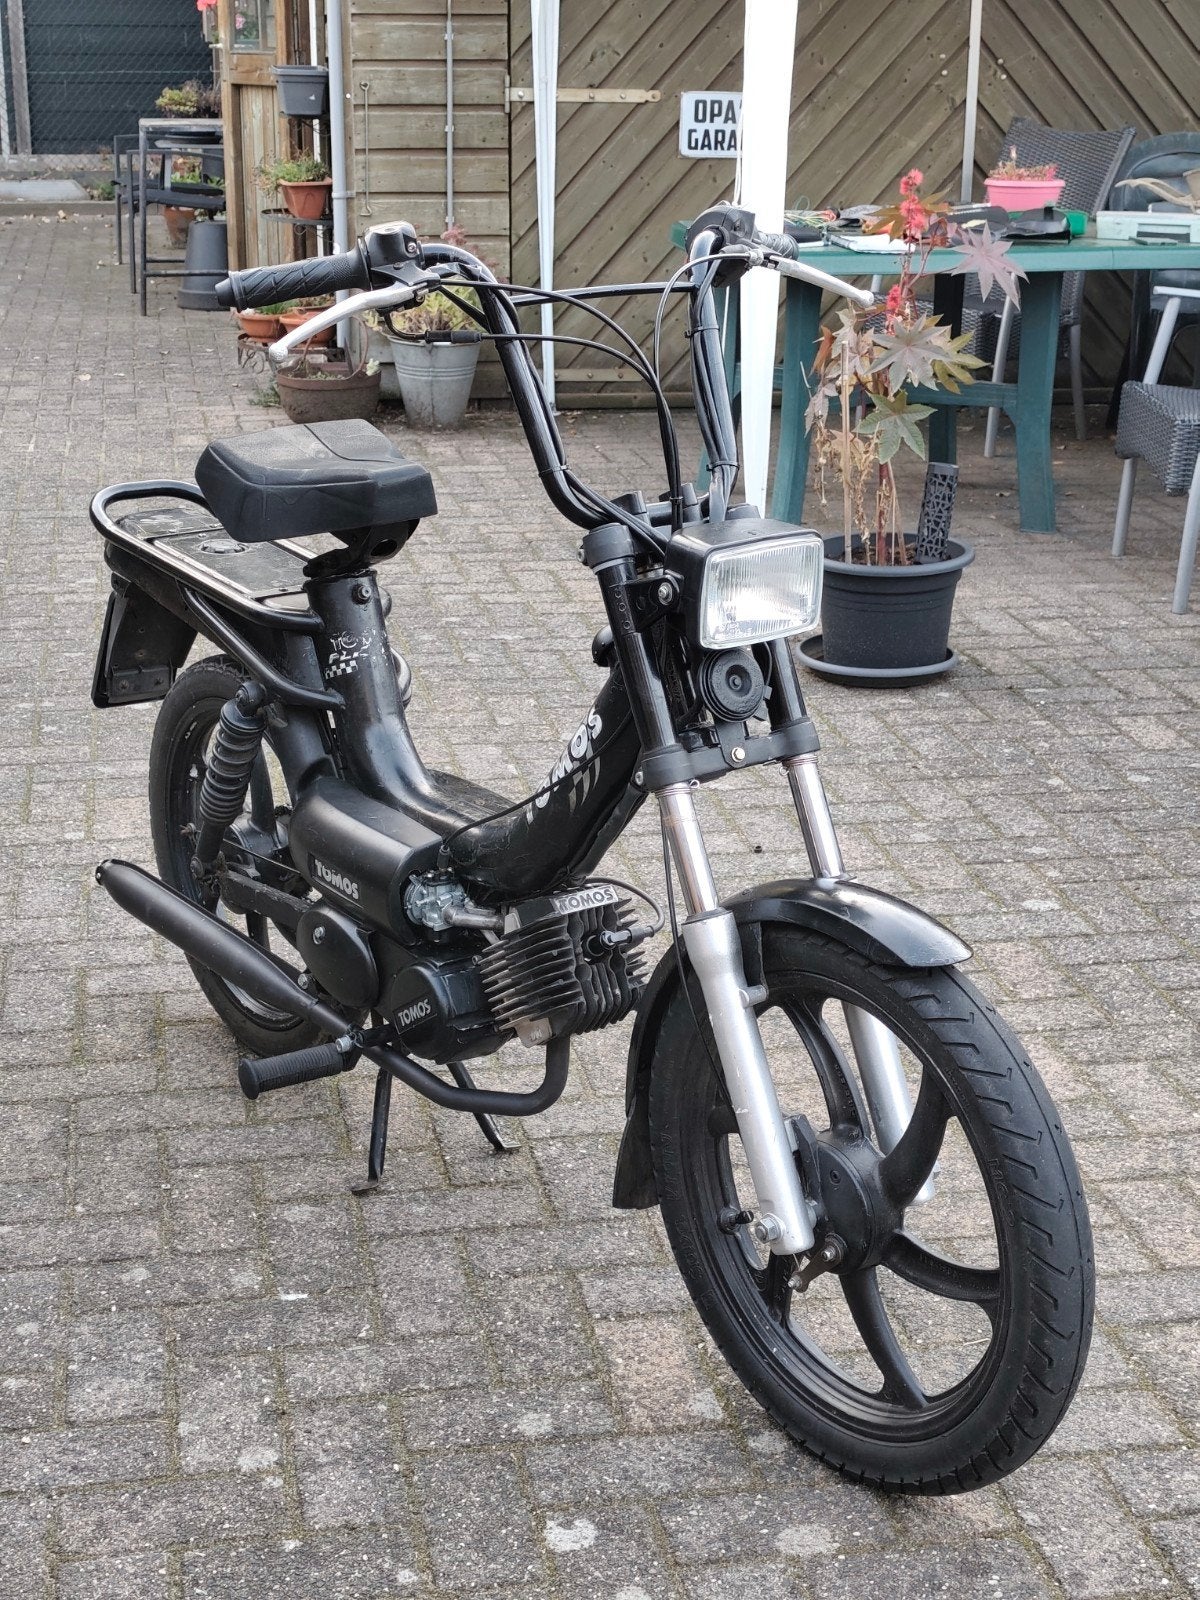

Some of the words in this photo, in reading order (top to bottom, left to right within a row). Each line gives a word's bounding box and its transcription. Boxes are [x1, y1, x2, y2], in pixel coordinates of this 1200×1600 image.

[687, 128, 742, 151] GARA
[314, 859, 359, 900] TOMOS
[558, 888, 614, 913] TOMOS
[397, 998, 431, 1027] TOMOS
